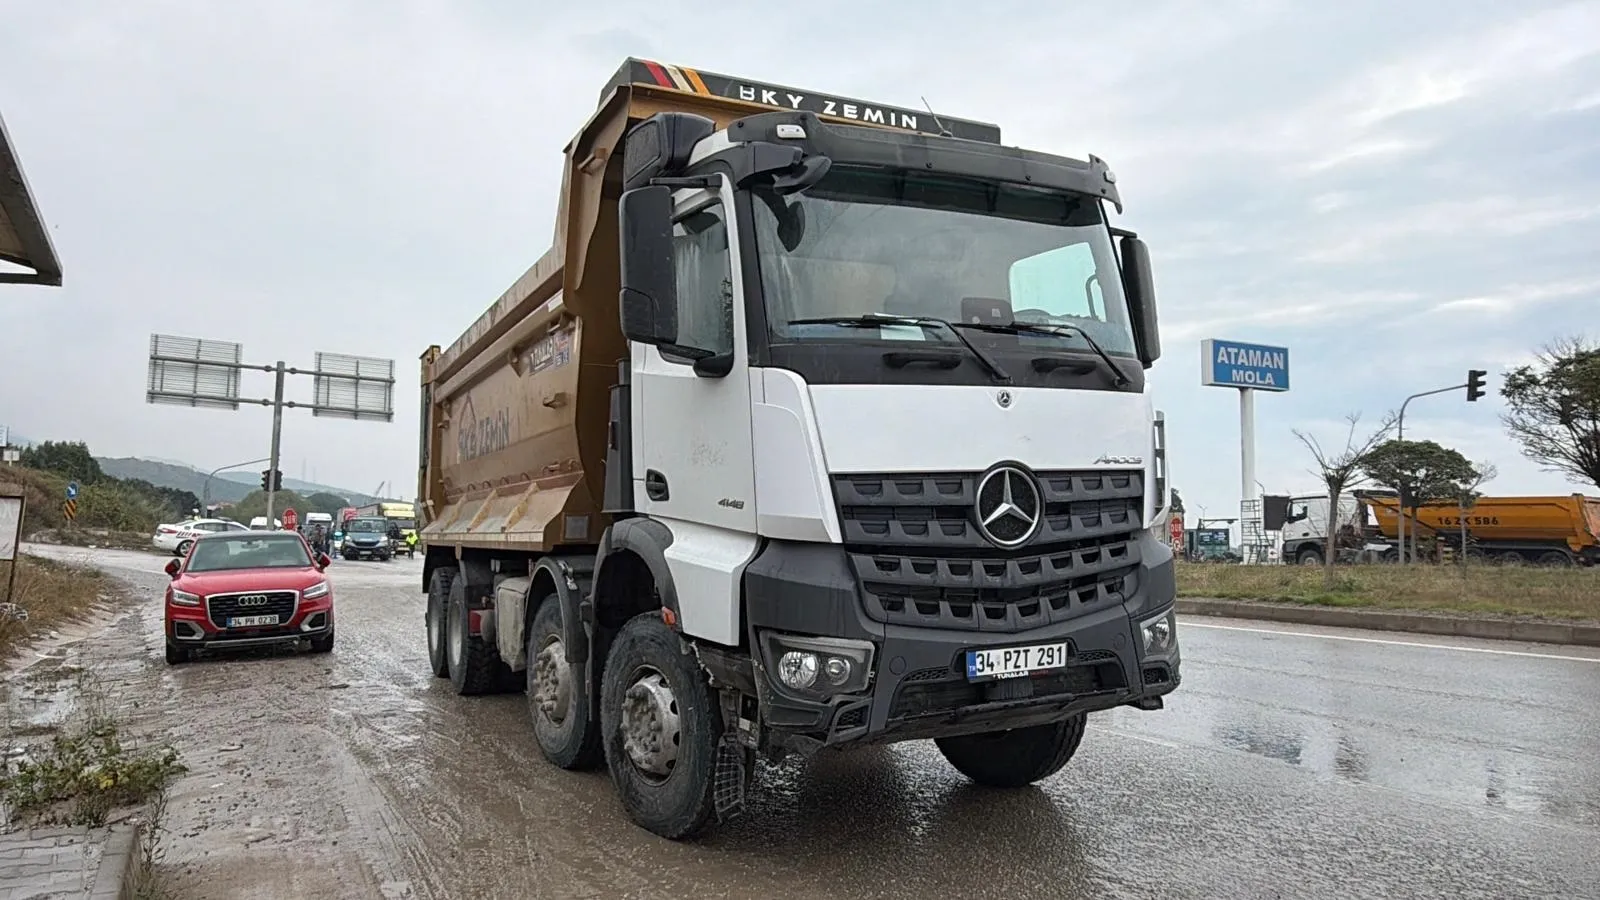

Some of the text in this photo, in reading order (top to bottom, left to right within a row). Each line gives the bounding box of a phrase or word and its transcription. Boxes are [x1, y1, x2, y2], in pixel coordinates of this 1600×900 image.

[739, 85, 917, 130] BKY ZEMIN
[1217, 346, 1284, 369] ATAMAN
[1231, 369, 1275, 385] MOLA
[717, 498, 744, 509] 4148
[283, 515, 297, 525] DUR
[1438, 516, 1452, 525] 16
[233, 618, 242, 626] 34
[976, 653, 994, 672] 34
[1004, 649, 1030, 670] PZT
[1037, 646, 1063, 667] 291
